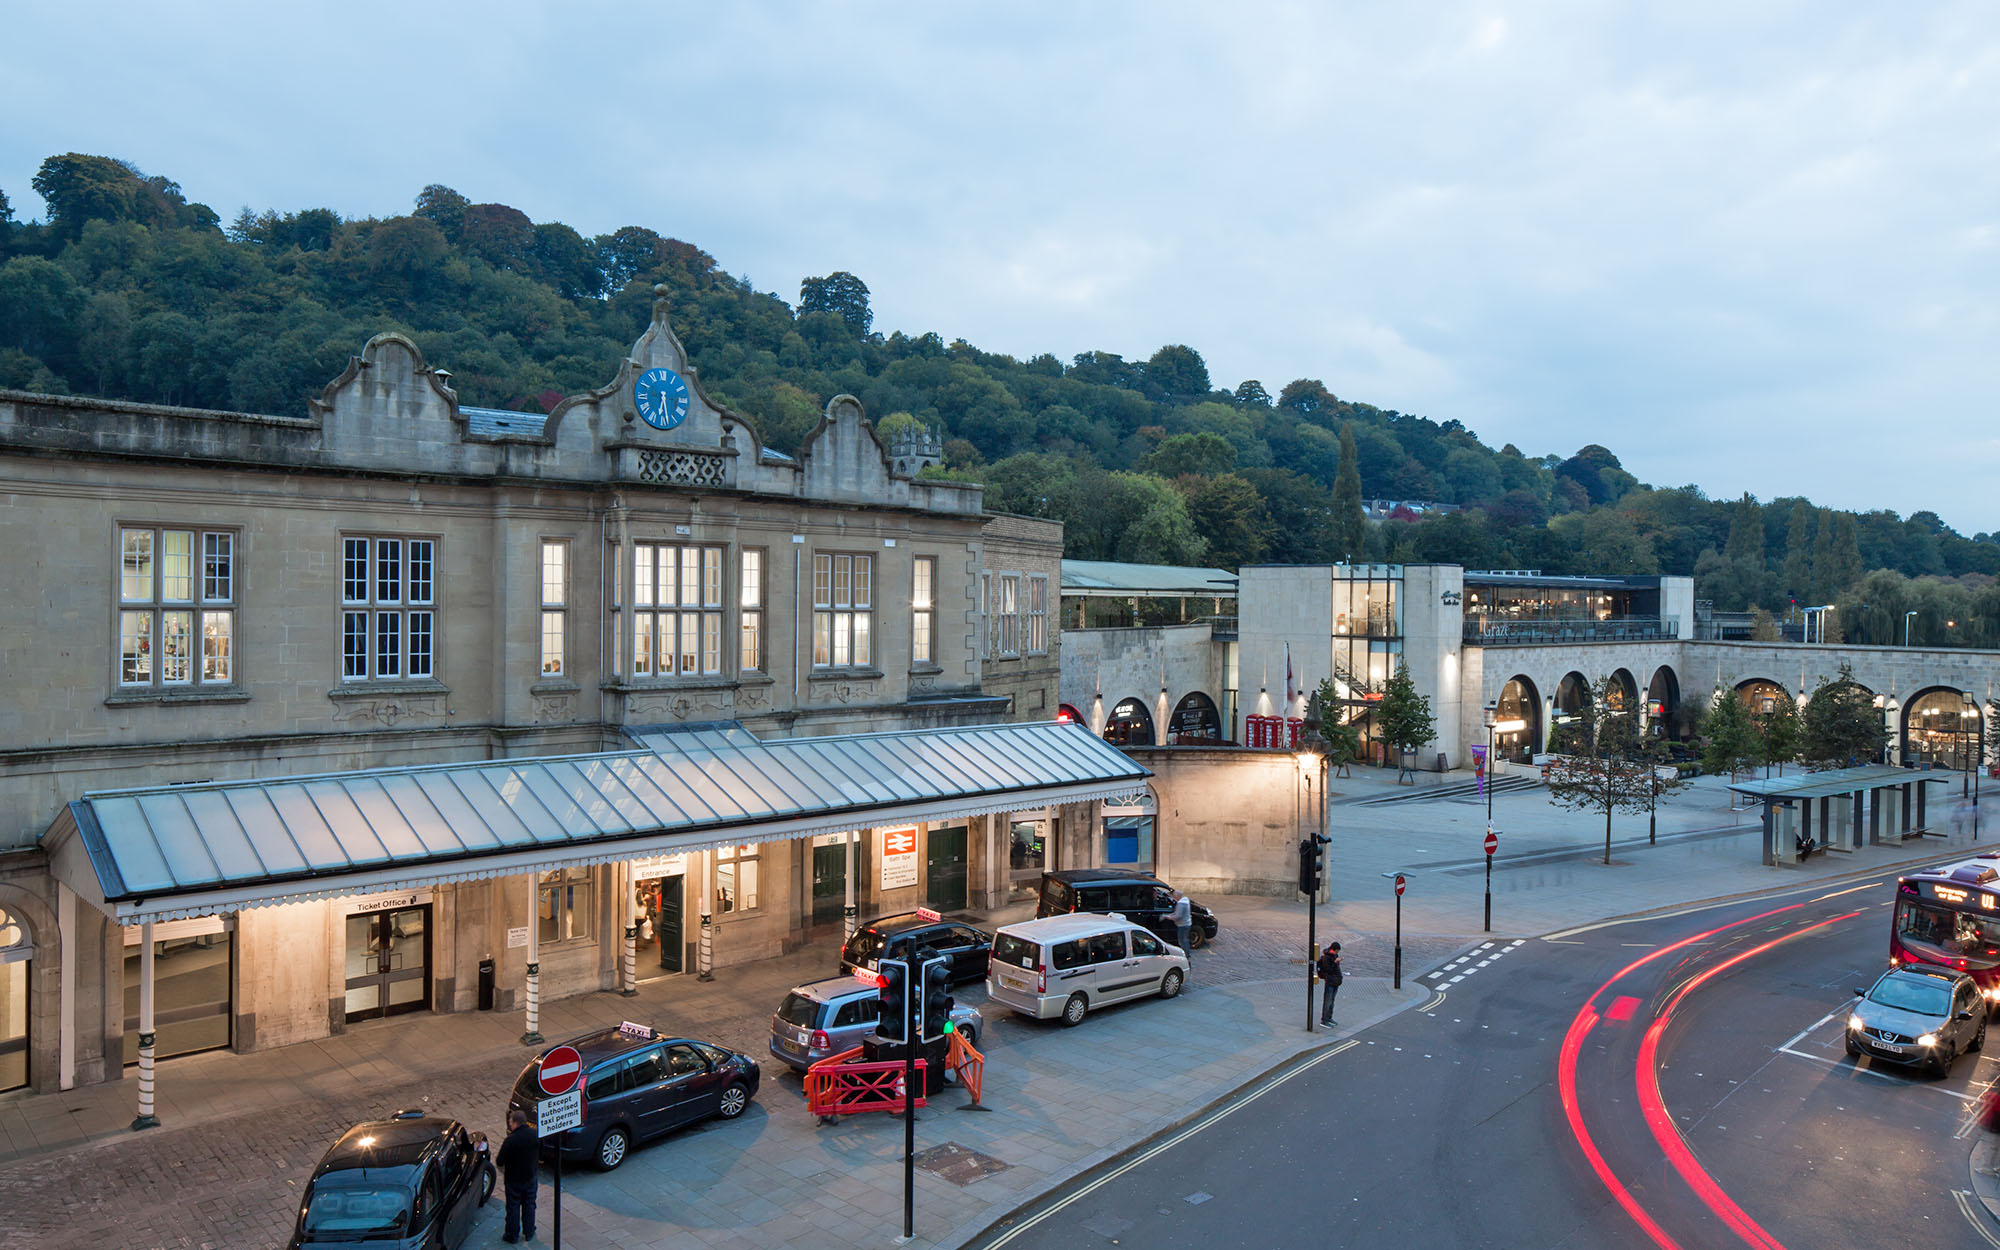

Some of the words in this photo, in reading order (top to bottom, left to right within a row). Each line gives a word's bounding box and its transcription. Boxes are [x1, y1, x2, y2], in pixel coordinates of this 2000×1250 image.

[1483, 620, 1509, 637] Graze
[642, 870, 670, 878] Entrance
[1934, 884, 1968, 898] University
[358, 902, 380, 911] Ticket
[382, 899, 406, 908] Office
[1982, 894, 1995, 910] U1
[860, 972, 874, 980] TAXI
[626, 1026, 644, 1036] TAXI
[548, 1096, 572, 1108] Except
[541, 1101, 578, 1118] authorised
[540, 1116, 554, 1126] taxi
[556, 1109, 578, 1122] permit
[546, 1120, 573, 1132] holders
